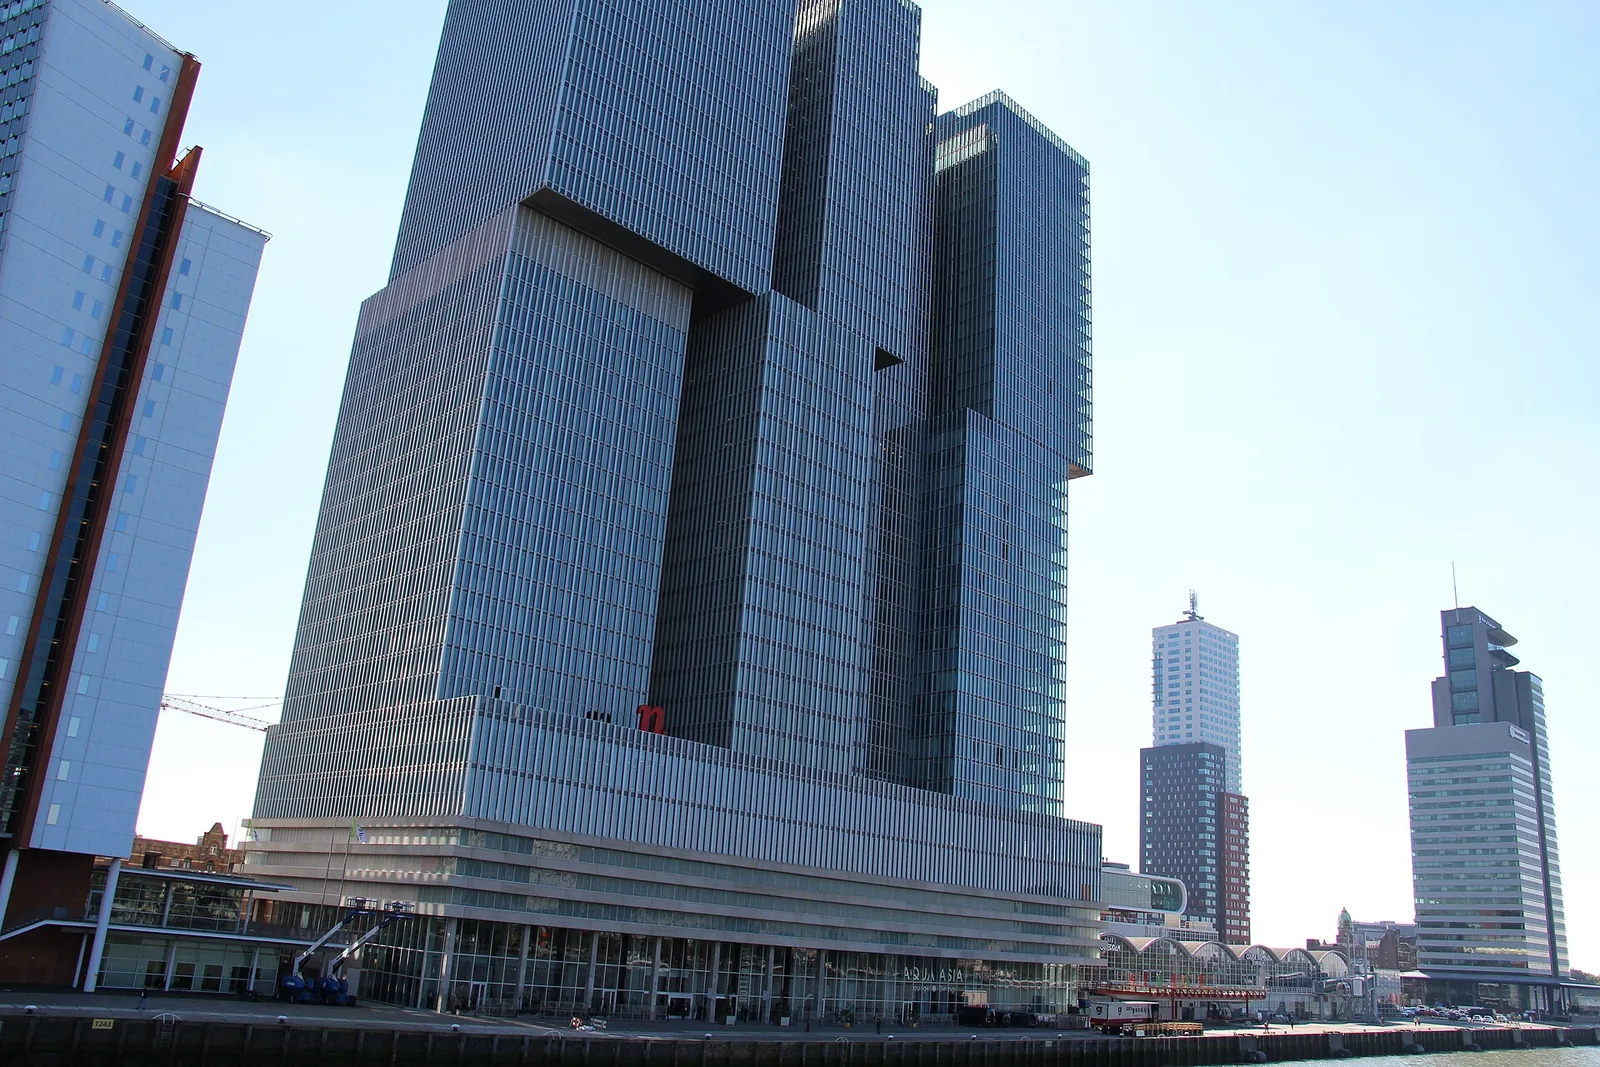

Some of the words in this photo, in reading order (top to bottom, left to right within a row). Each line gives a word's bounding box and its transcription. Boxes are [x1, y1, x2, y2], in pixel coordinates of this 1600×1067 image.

[904, 966, 935, 982] AQUA
[939, 968, 964, 982] ASIA
[94, 1020, 112, 1028] 1243
